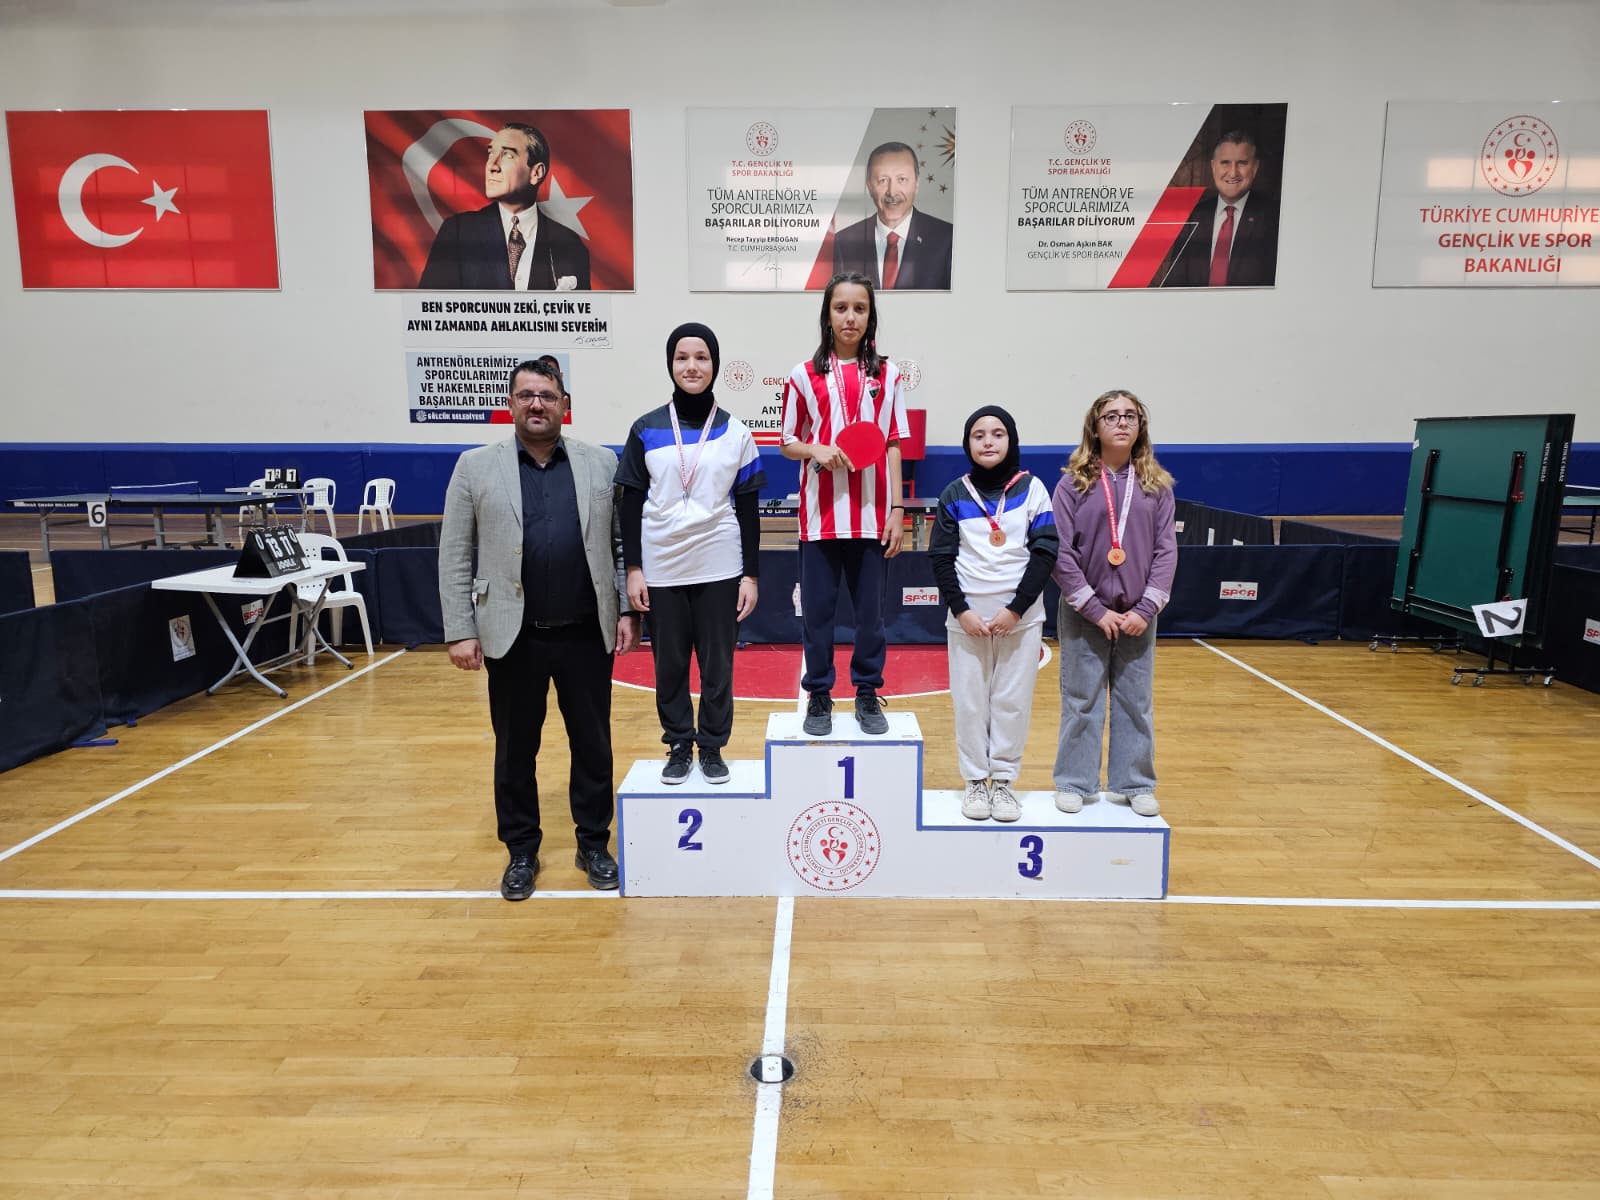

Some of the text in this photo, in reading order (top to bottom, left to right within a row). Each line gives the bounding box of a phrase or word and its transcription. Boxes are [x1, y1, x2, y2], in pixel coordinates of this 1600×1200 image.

[748, 160, 782, 169] GENÇLİK
[1048, 158, 1111, 167] T.C. GENÇLİK VE
[754, 168, 794, 177] BAKANLIĞI
[1070, 167, 1111, 175] BAKANLIĞI
[707, 187, 818, 200] TÜM ANTRENÖR VE
[1022, 185, 1134, 200] TÜM ANTRENÖR VE
[712, 202, 814, 214] SPORCULARIMIZA
[1024, 201, 1130, 214] SPORCULARIMIZA
[1420, 205, 1600, 223] TÜRKİYE CUMHURİYE
[705, 217, 820, 230] BAŞARILAR DİLİYORUM
[1018, 215, 1135, 228] BAŞARILAR DİLİYORUM
[726, 236, 744, 244] Recep
[746, 236, 766, 244] Tayyip
[1038, 240, 1048, 248] Dr.
[1050, 240, 1074, 248] Osman
[1076, 240, 1096, 248] Aşkın
[1438, 230, 1592, 252] GENÇLİK VE SPOR
[740, 245, 796, 253] CUMHURBAŞKANI
[1028, 250, 1123, 260] GENÇLİK VE SPOR BAKANI
[1464, 255, 1562, 273] BAKANLIĞI
[422, 300, 592, 316] BEN SPORCUNUN ZEKİ, ÇEVİK VE
[407, 318, 607, 332] AYNI ZAMANDA AHLAKLISINI SEVERİM
[416, 355, 518, 368] ANTRENÖRLERİMİZE
[420, 381, 508, 394] VE HAKEMLERİMİ
[419, 394, 508, 408] BAŞARILAR DİLER
[762, 406, 782, 414] ANT
[91, 504, 105, 524] 6
[1222, 589, 1256, 597] SPOR
[1481, 606, 1522, 634] 2
[838, 756, 854, 799] 1
[678, 808, 703, 851] 2
[1018, 834, 1044, 878] 3
